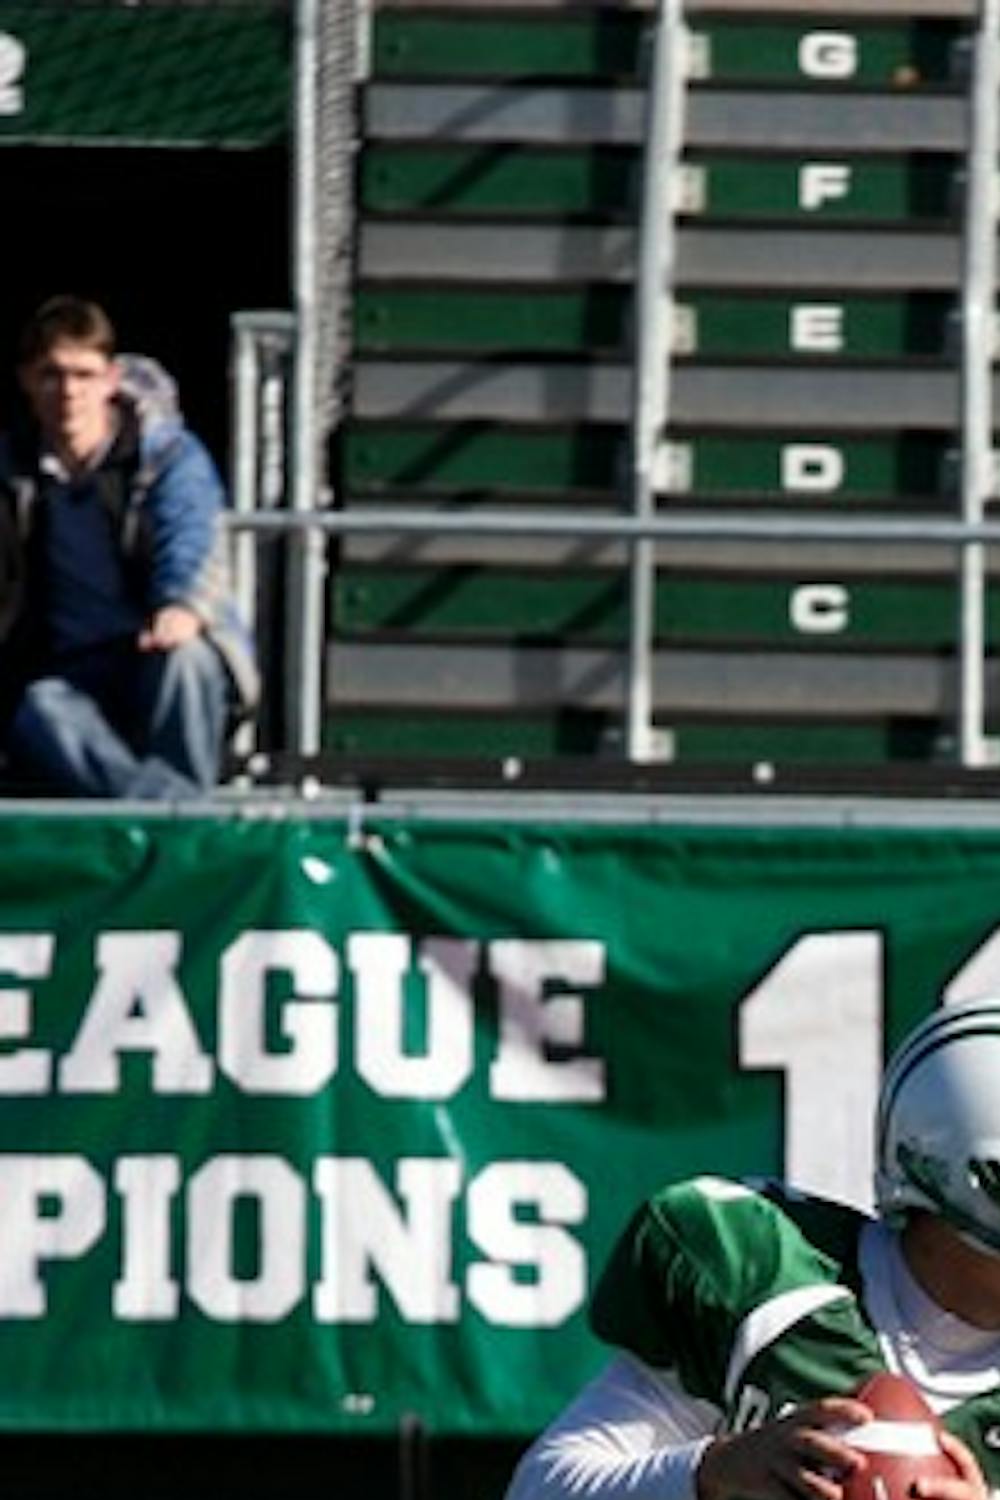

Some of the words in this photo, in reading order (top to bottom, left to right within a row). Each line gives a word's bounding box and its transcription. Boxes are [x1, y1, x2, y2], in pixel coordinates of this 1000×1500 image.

[798, 32, 858, 79] G
[799, 164, 851, 211] F
[790, 304, 844, 352] E
[781, 443, 844, 493] D
[789, 584, 849, 634] C
[0, 1153, 588, 1328] PIONS
